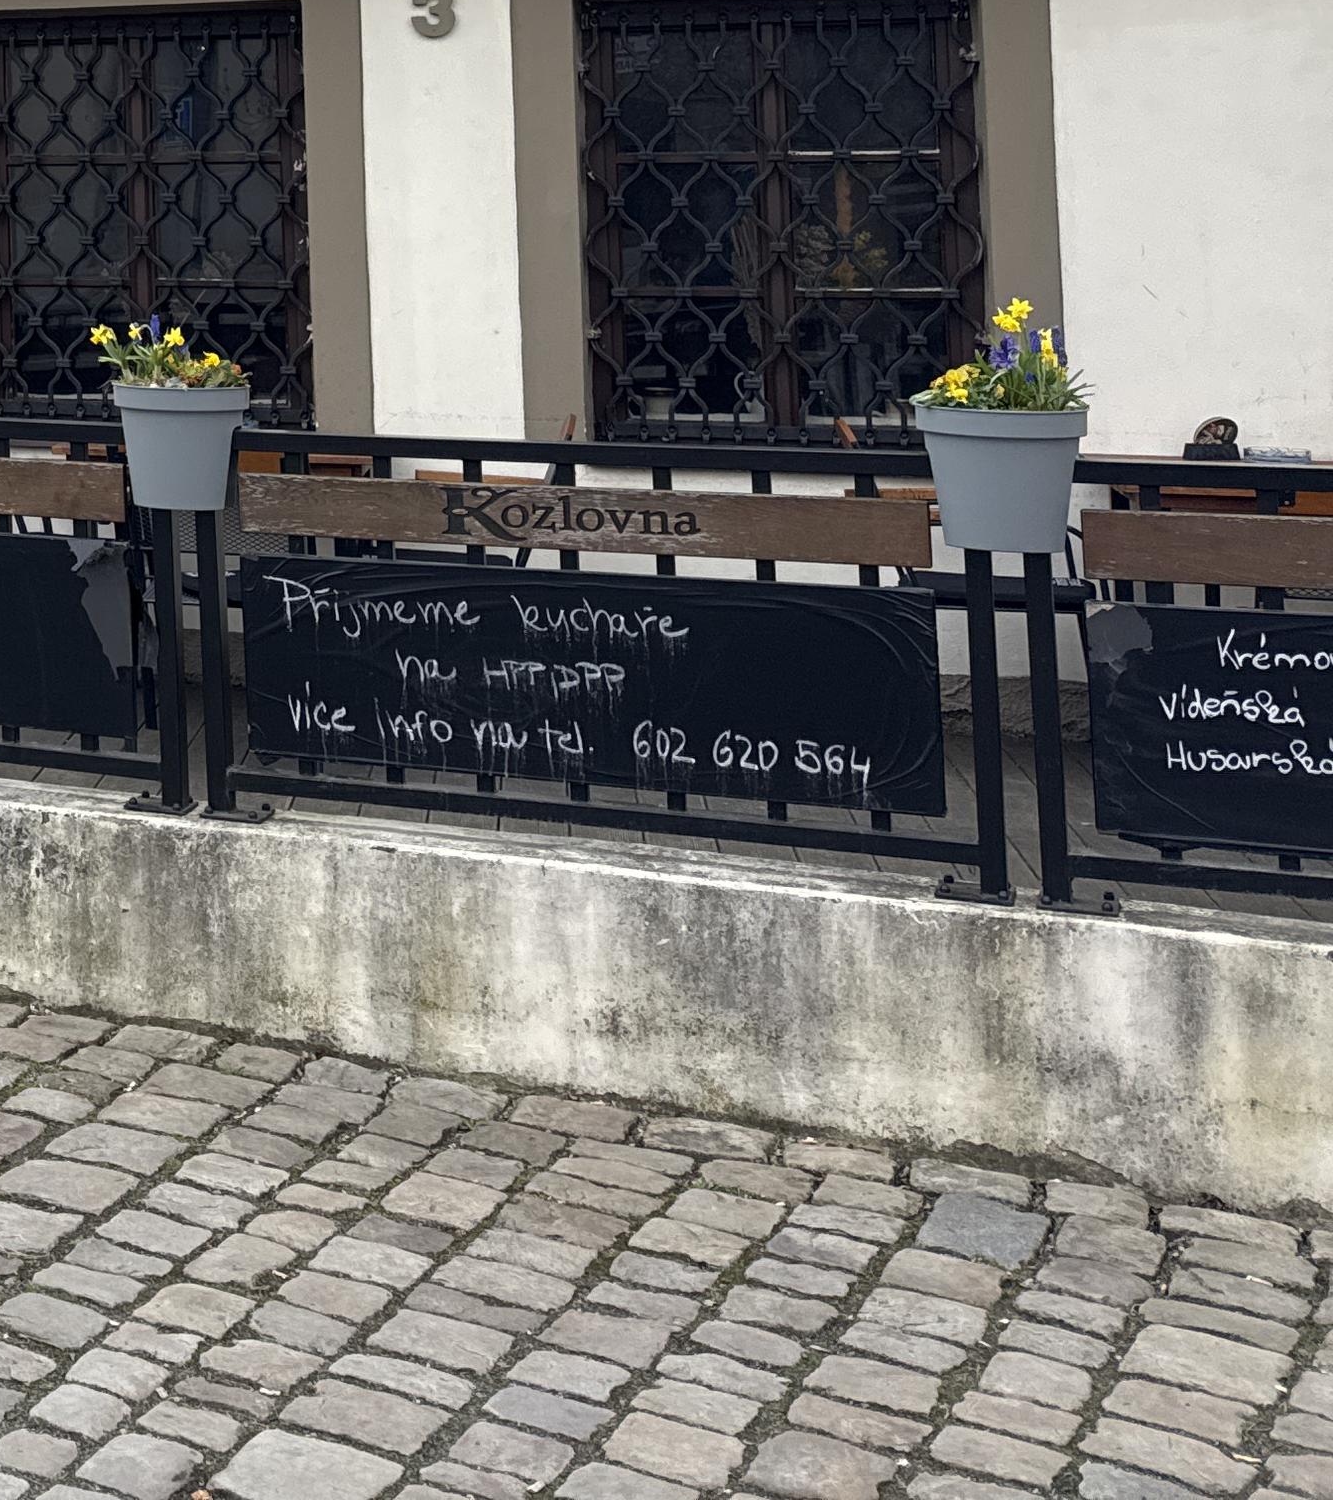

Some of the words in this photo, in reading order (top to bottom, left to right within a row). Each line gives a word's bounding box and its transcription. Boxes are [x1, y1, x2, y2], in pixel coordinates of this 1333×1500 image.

[439, 485, 701, 542] Kozlovna
[395, 648, 457, 683] na
[1216, 628, 1333, 670] Krémo
[1158, 683, 1306, 728] Vídeňská
[470, 718, 528, 750] na
[538, 718, 594, 754] tel.
[633, 720, 696, 764] 602
[712, 729, 779, 771] 620
[794, 739, 871, 788] 564
